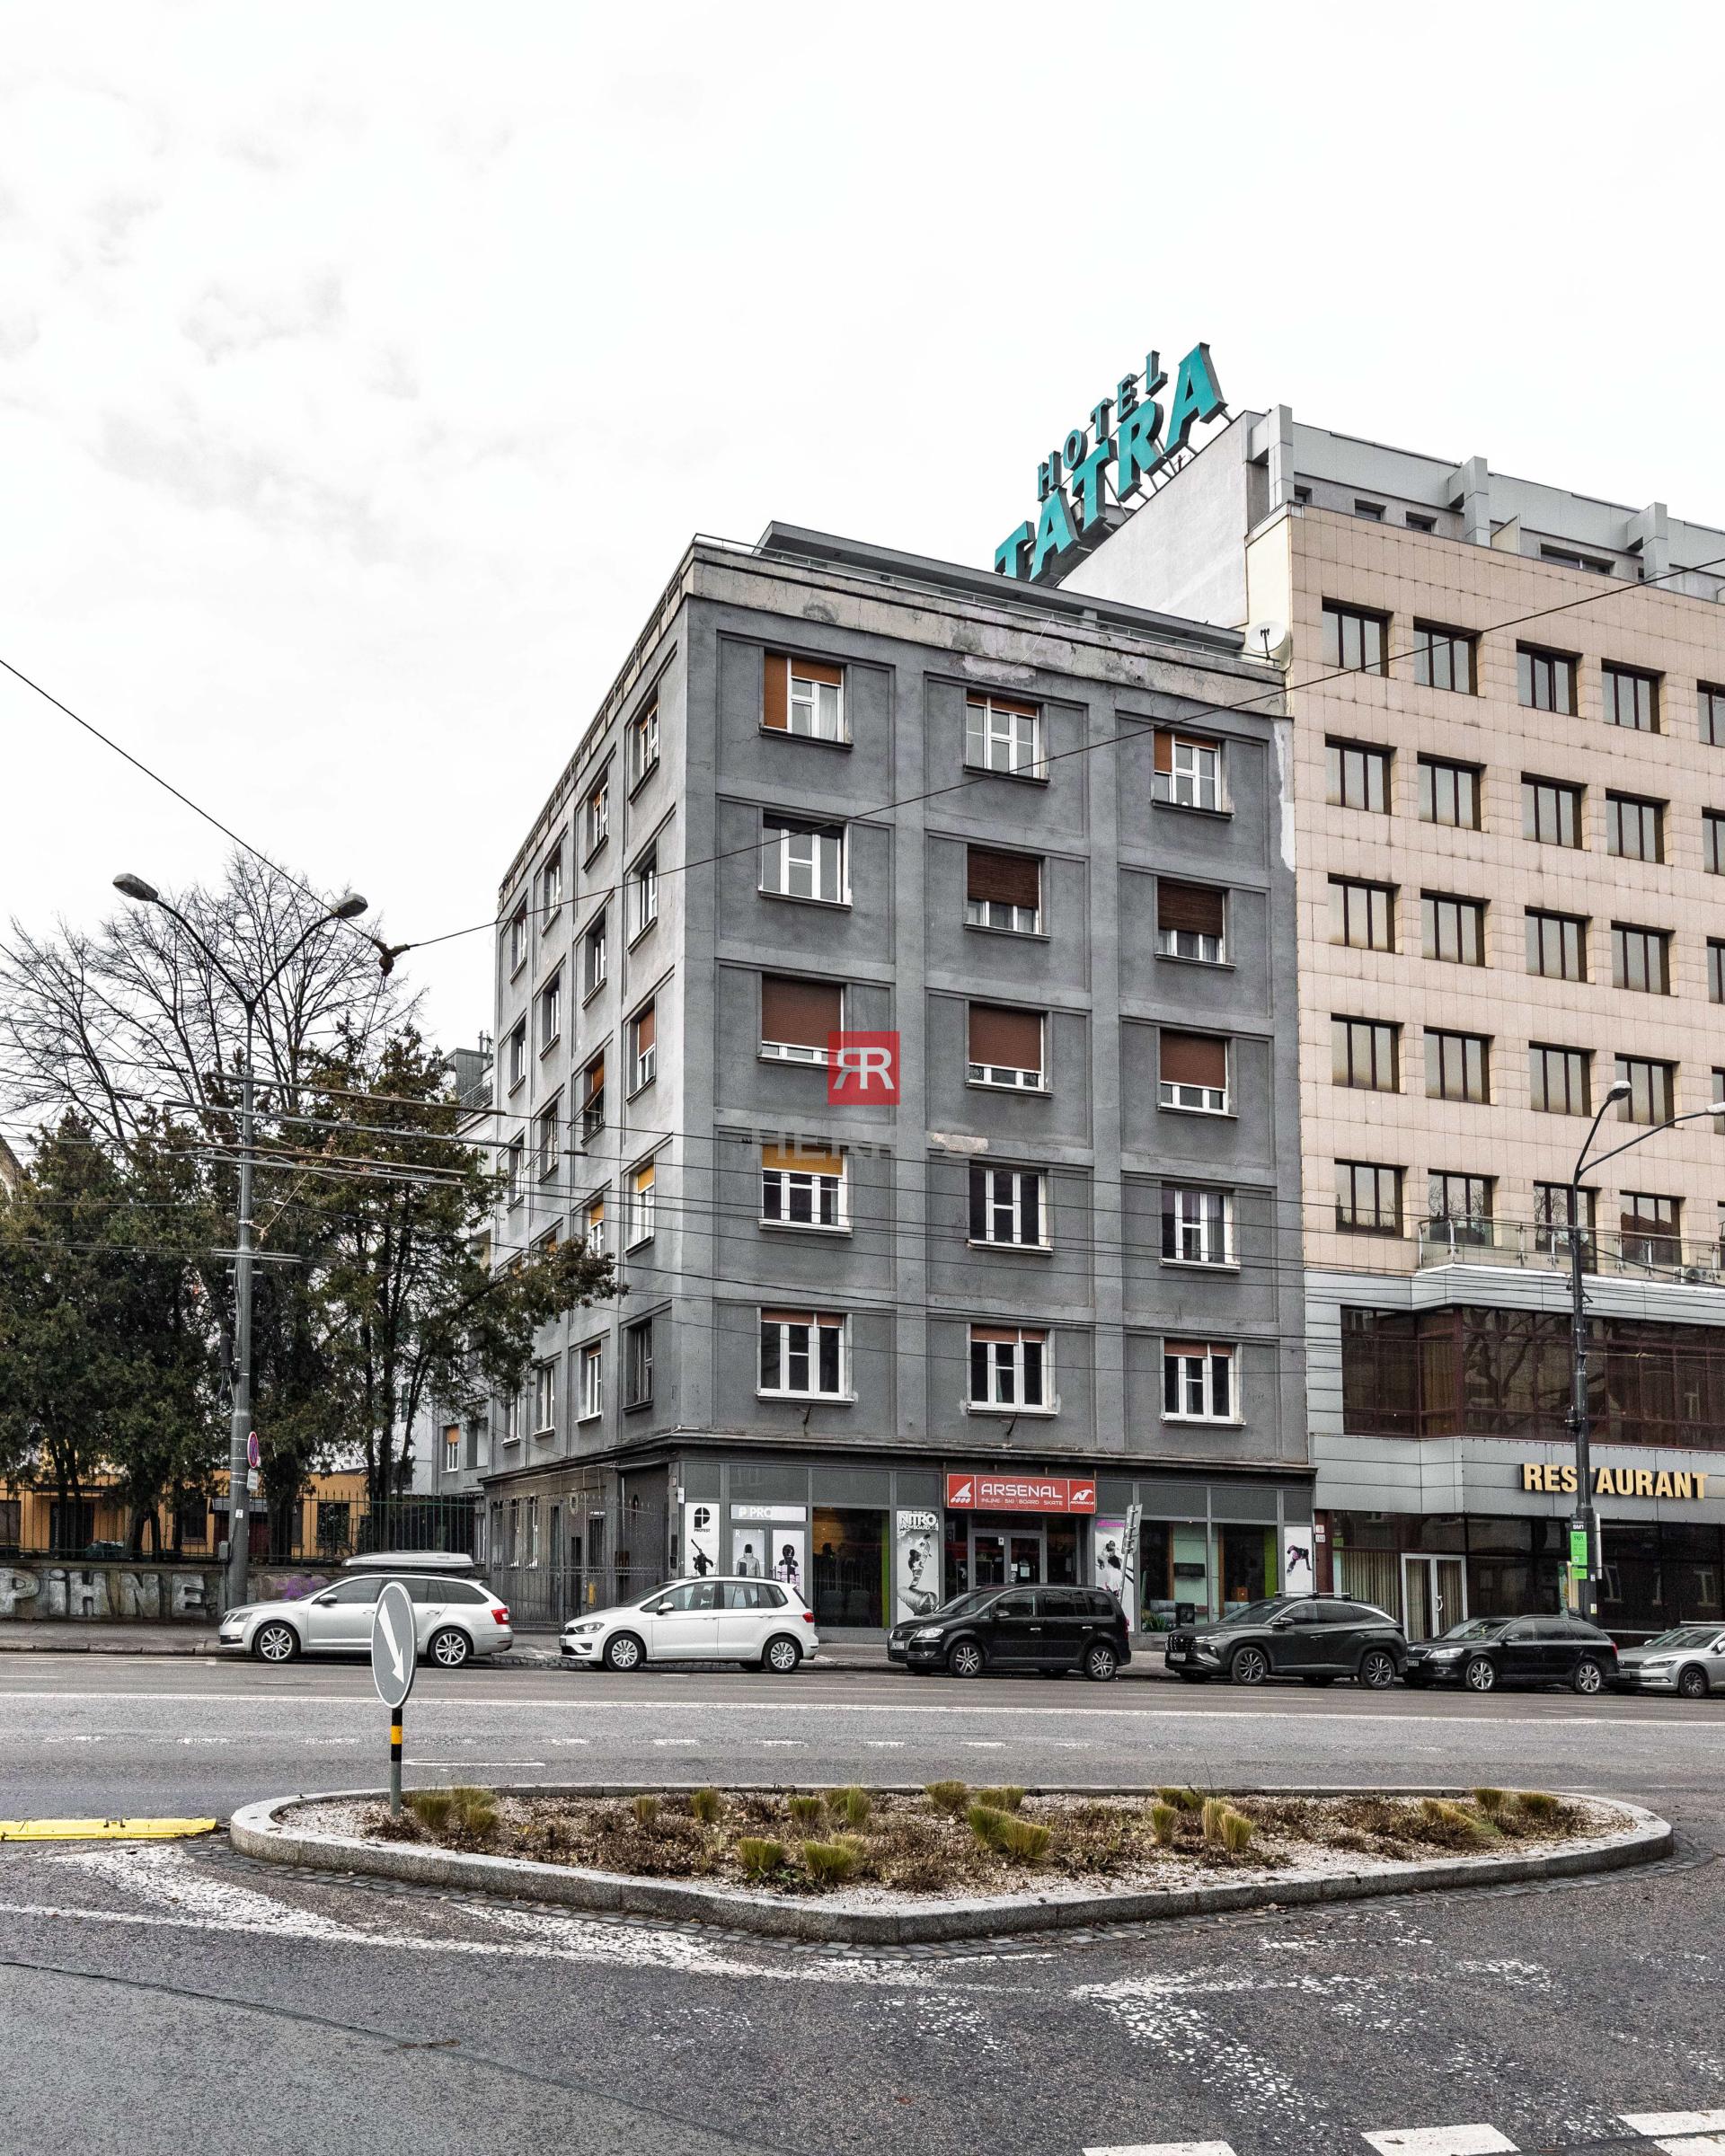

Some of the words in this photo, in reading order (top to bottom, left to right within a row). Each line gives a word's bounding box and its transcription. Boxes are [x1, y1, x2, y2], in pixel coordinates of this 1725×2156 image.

[1037, 349, 1168, 502] HOTEL
[995, 341, 1229, 582] TATRA
[980, 1483, 1063, 1498] ARSENAL
[1523, 1462, 1710, 1499] RESAURANT
[899, 1513, 936, 1526] NITRO
